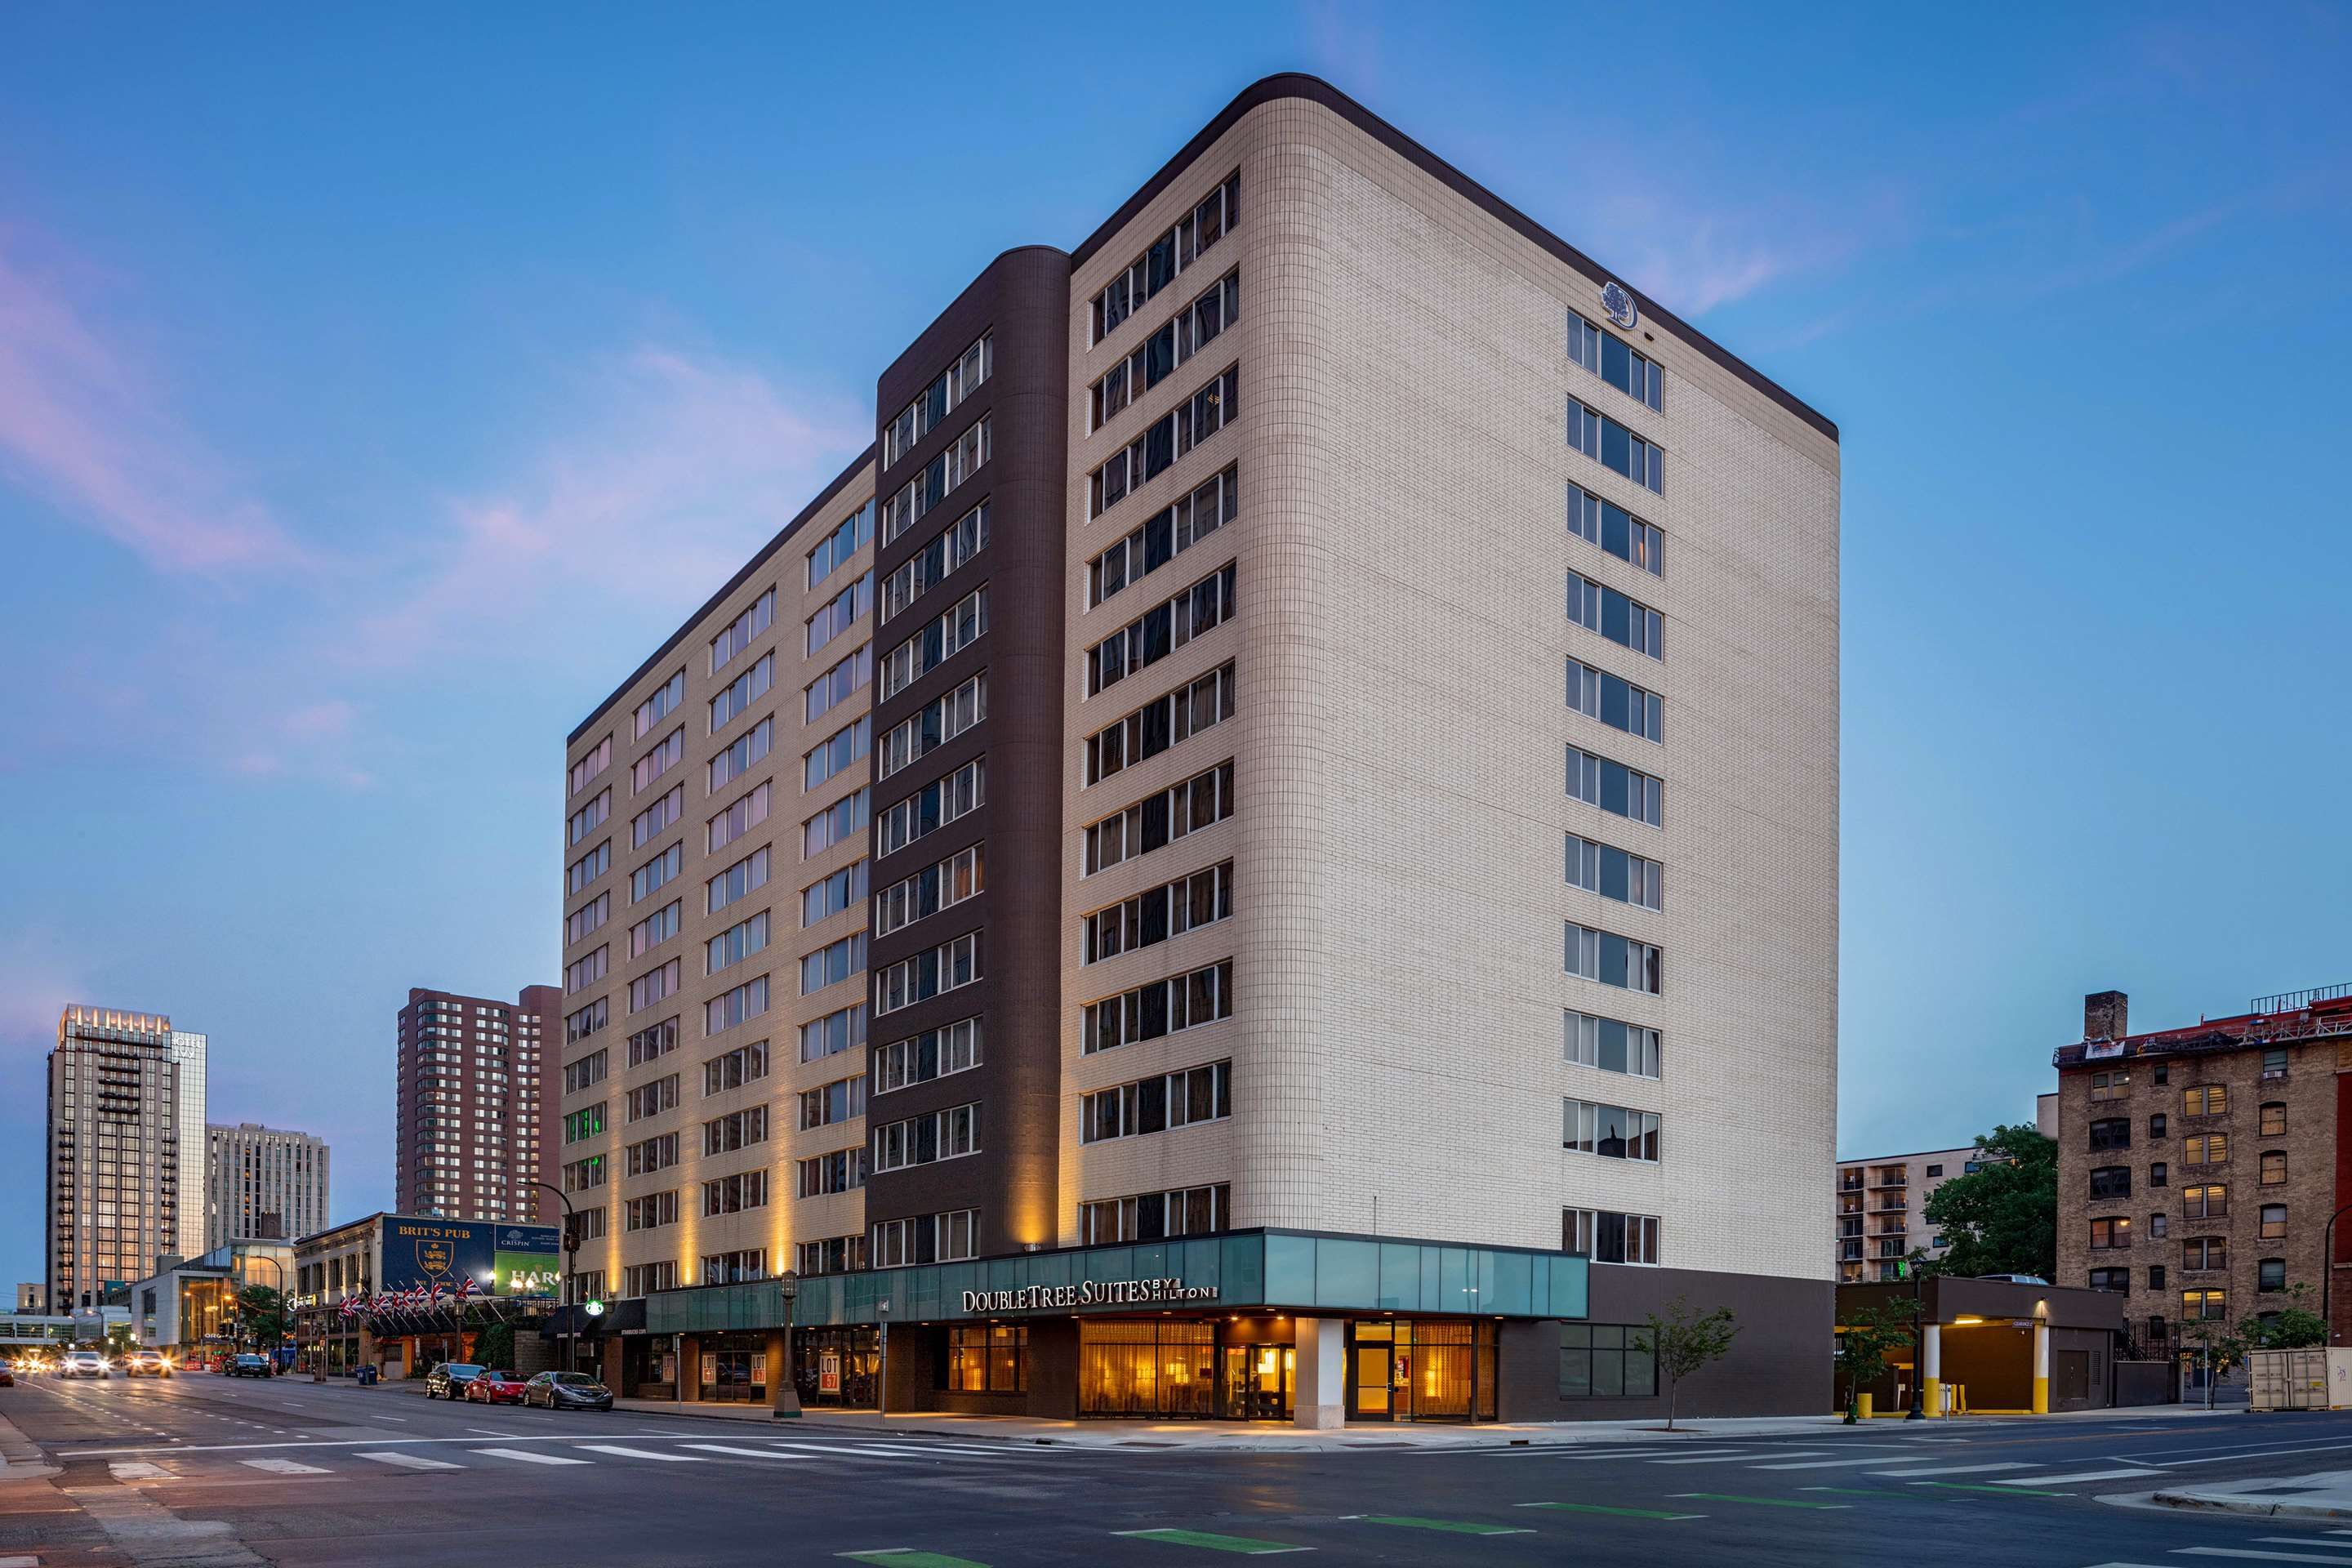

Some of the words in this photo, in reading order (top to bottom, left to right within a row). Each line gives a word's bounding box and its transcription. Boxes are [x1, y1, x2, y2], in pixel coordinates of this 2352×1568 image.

[399, 1226, 441, 1237] BRIT'S
[444, 1228, 471, 1239] PUB
[511, 1270, 559, 1286] HAR
[1152, 1278, 1172, 1289] BY
[962, 1285, 1077, 1312] DOUBLETREE
[1081, 1280, 1150, 1304] SUITES
[1152, 1288, 1209, 1300] HILTON
[703, 1356, 715, 1369] LOT
[752, 1356, 764, 1369] LOT
[822, 1358, 838, 1373] LOT
[826, 1374, 836, 1388] 57
